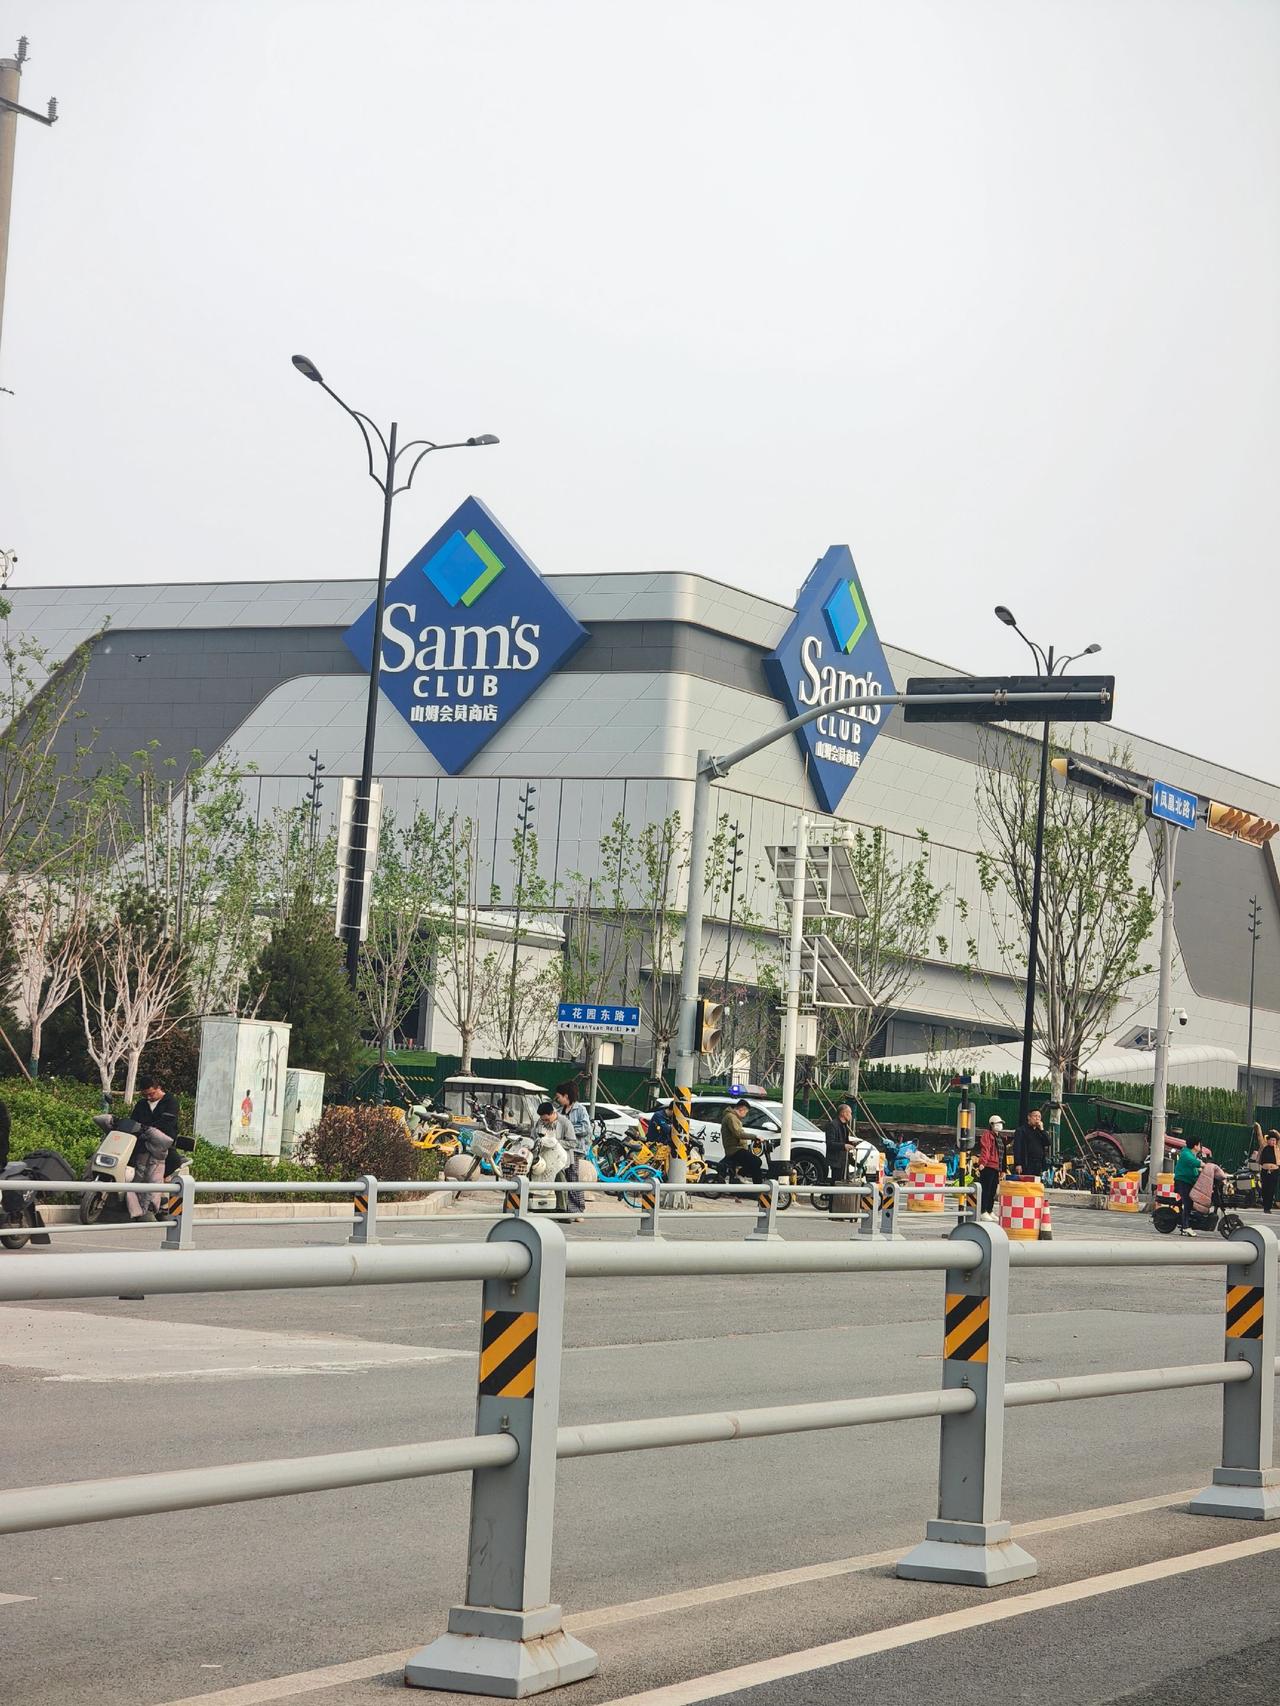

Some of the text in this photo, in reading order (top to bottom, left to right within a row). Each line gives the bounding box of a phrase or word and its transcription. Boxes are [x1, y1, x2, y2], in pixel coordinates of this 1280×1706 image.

[380, 603, 540, 673] Sam's
[413, 675, 498, 698] CLUB
[799, 636, 882, 724] Sam's
[411, 705, 498, 722] 山姆会员商店
[816, 716, 861, 744] CLUB
[1160, 791, 1190, 819] 凤凰北路
[572, 1007, 625, 1022] 花园东路
[697, 1125, 721, 1144] 公安
